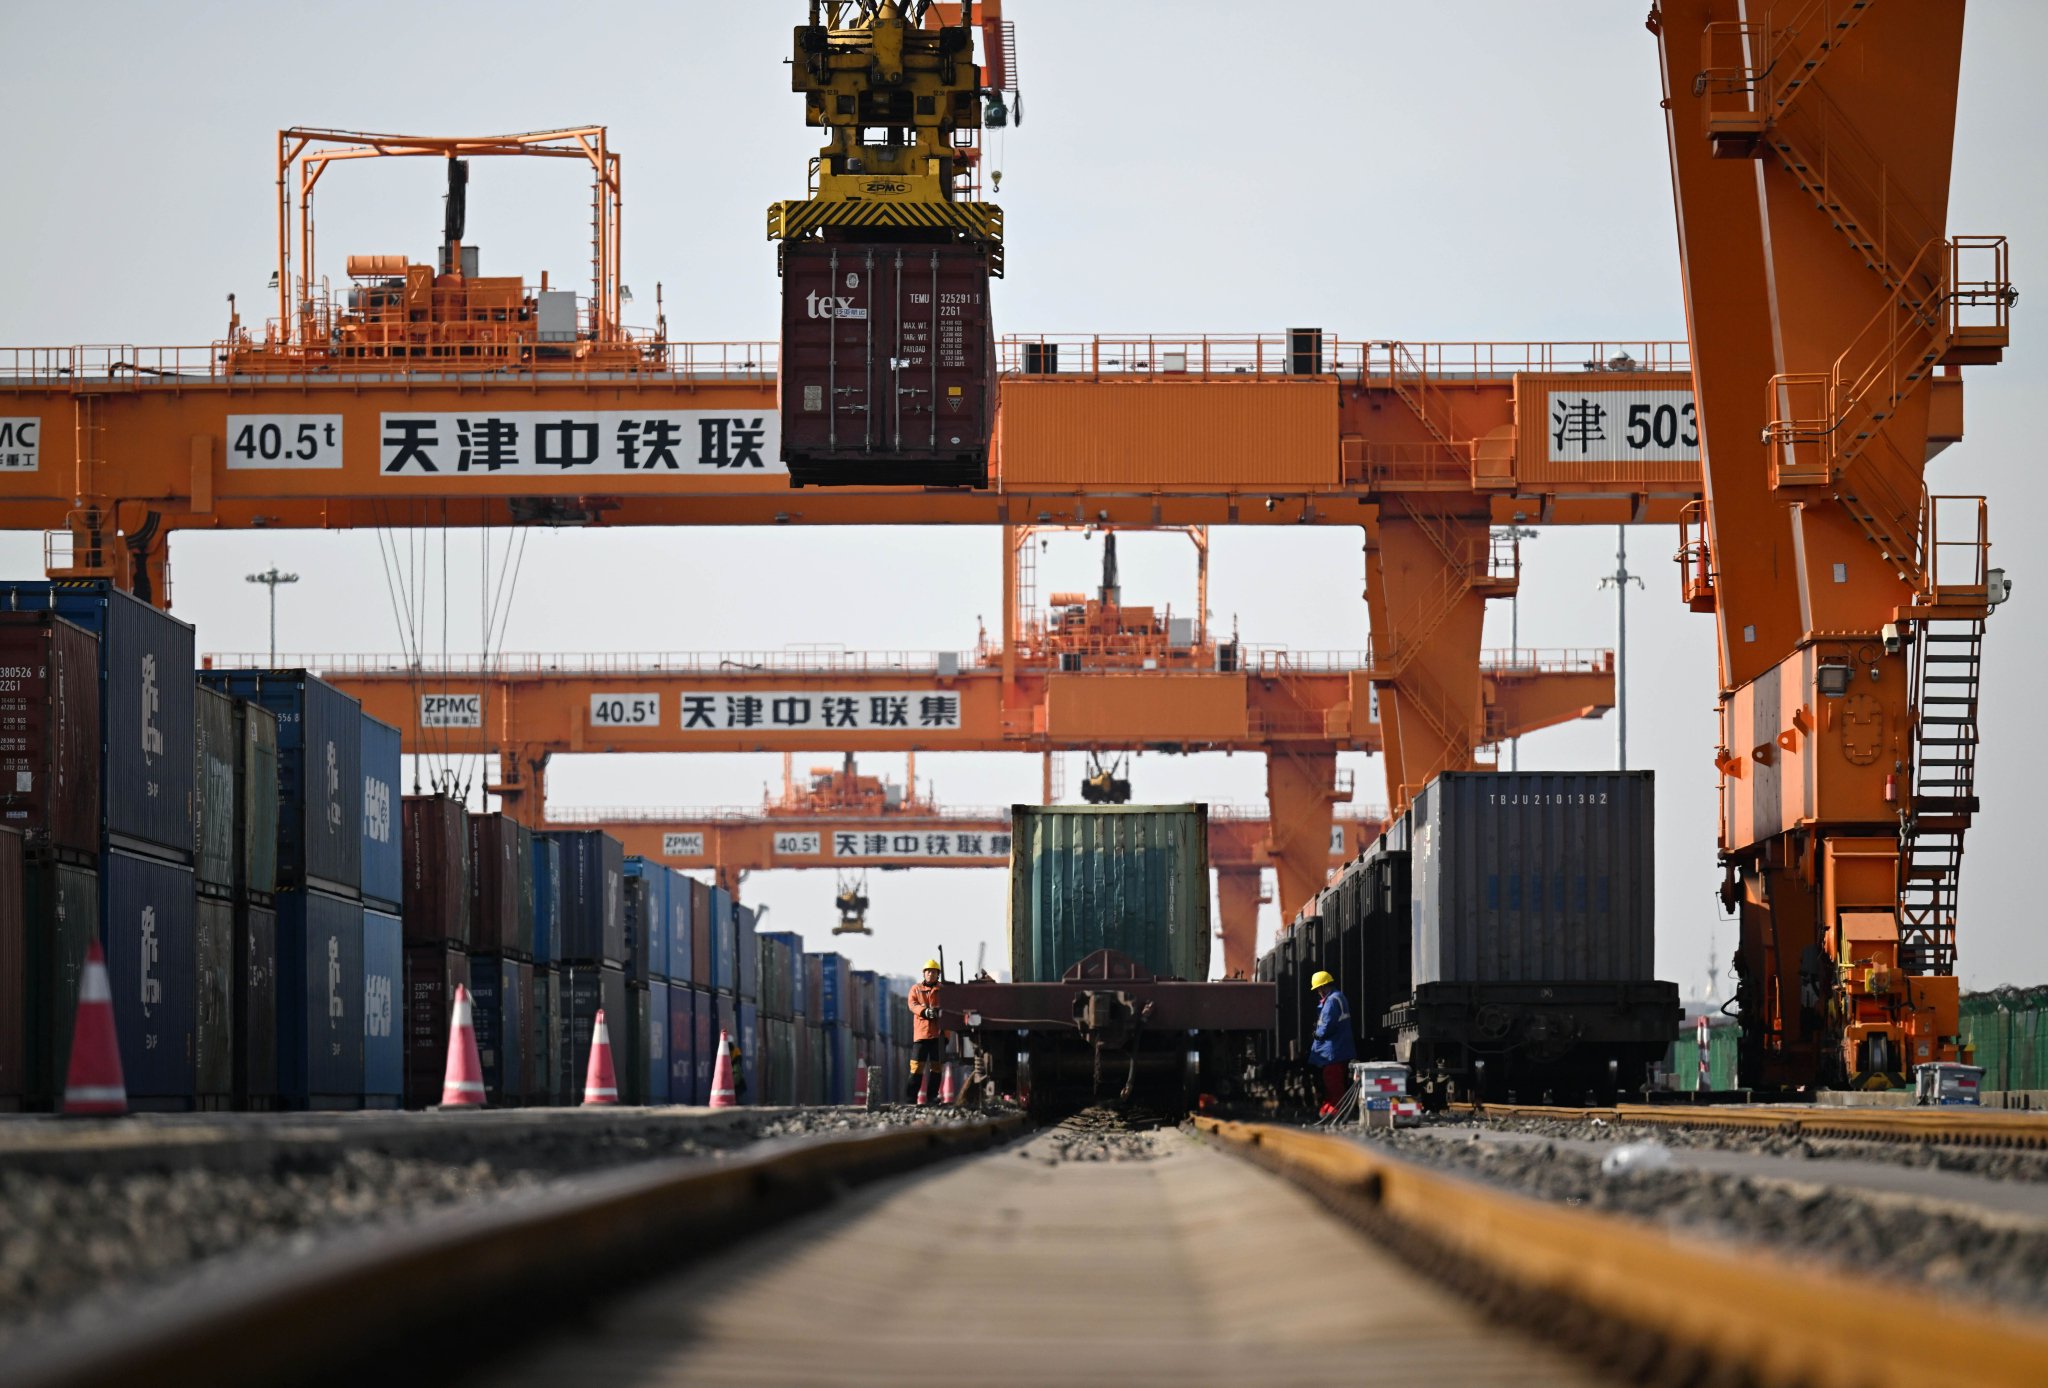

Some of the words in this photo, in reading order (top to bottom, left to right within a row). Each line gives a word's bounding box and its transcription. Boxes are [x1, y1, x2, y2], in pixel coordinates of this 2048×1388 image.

[867, 184, 906, 192] ZPMC
[806, 289, 855, 318] tex
[910, 294, 930, 304] TEMU
[940, 294, 971, 304] 325291
[940, 306, 960, 316] 22G1
[1552, 398, 1607, 454] 津
[1626, 402, 1699, 450] 503
[234, 423, 336, 460] 40.5t
[383, 418, 766, 472] 天津中铁联
[0, 454, 35, 466] 重工
[0, 680, 20, 691] 22G1
[425, 698, 478, 712] ZPMC
[596, 700, 655, 724] 40.5t
[682, 696, 958, 728] 天津中铁联集
[1490, 793, 1608, 805] TBJU2101382
[666, 836, 700, 847] ZPMC
[778, 838, 818, 853] 40.5t
